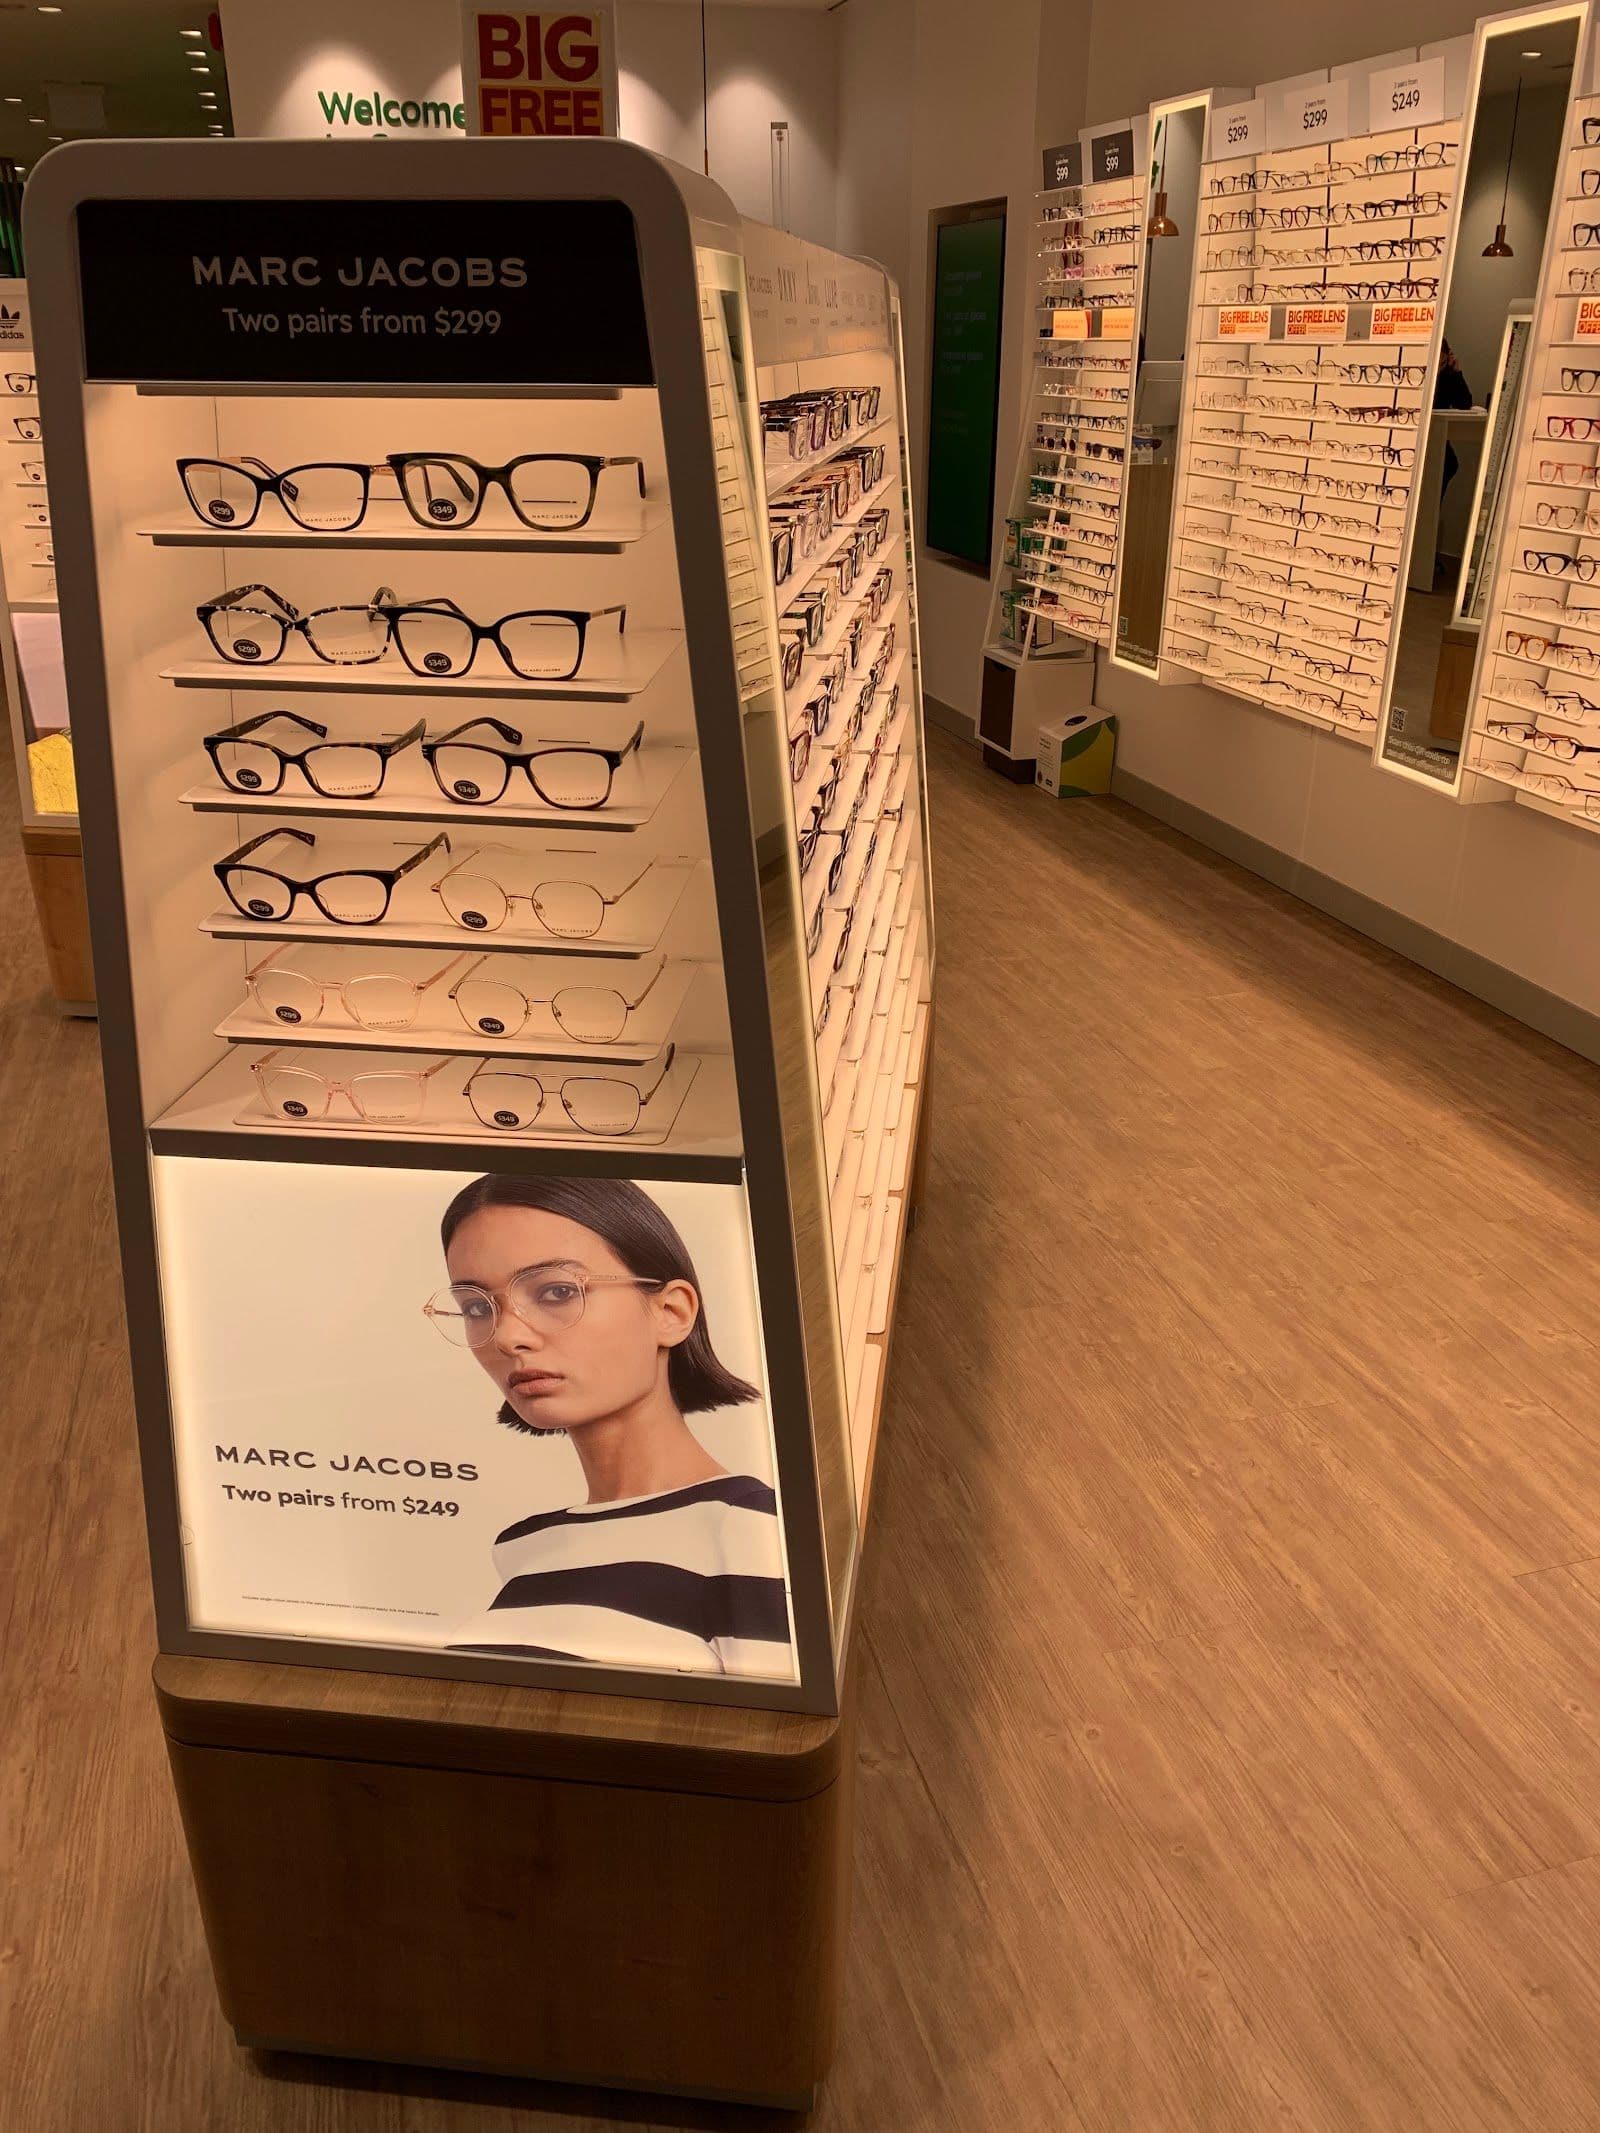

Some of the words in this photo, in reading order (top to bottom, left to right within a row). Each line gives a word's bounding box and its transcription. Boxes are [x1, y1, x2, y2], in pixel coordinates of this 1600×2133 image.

[477, 14, 599, 82] BIG
[317, 91, 466, 129] Welcome
[1392, 90, 1420, 112] $249
[481, 87, 600, 136] FREE
[1303, 109, 1328, 129] $299
[1228, 125, 1248, 144] $299
[1056, 166, 1069, 182] $99
[1106, 156, 1119, 172] $99
[192, 256, 321, 286] MARC
[338, 256, 528, 288] JACOBS
[222, 307, 279, 333] Two
[287, 306, 352, 339] pairs
[360, 306, 426, 334] from
[434, 306, 501, 337] $299
[1220, 311, 1232, 323] BIG
[1232, 310, 1249, 323] FREE
[1250, 310, 1269, 323] LENS
[1288, 310, 1302, 323] BIG
[1303, 309, 1323, 323] FREE
[1323, 309, 1346, 323] LENS
[1374, 308, 1390, 322] BIG
[1390, 307, 1414, 322] FREE
[432, 504, 453, 514] $349
[427, 658, 447, 667] $349
[215, 1445, 317, 1469] MARC
[330, 1455, 479, 1481] JACOBS
[222, 1485, 272, 1502] Two
[278, 1489, 335, 1508] pairs
[341, 1492, 396, 1512] from
[403, 1496, 460, 1517] $249
